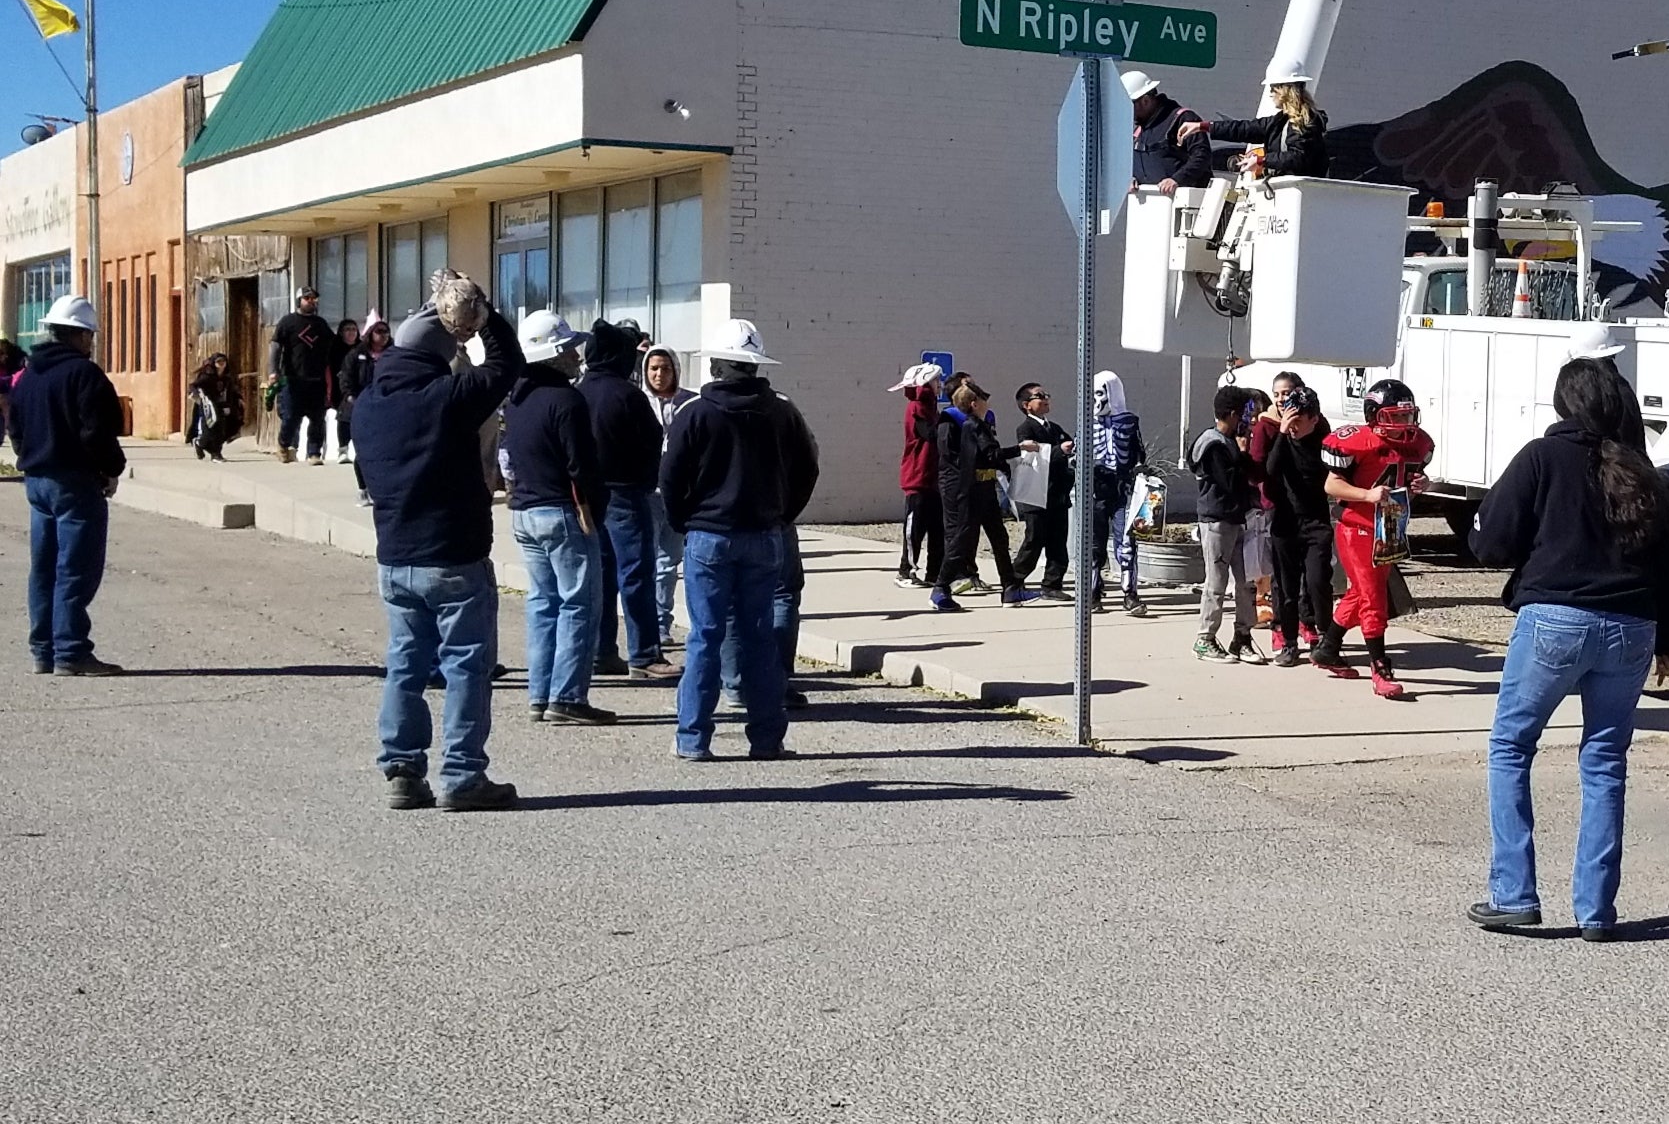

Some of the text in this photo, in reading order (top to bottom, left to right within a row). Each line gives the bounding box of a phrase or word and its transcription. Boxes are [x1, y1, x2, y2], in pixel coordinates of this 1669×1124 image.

[1019, 0, 1140, 58] Ripley
[1160, 15, 1207, 44] Ave
[1267, 215, 1289, 234] Altec
